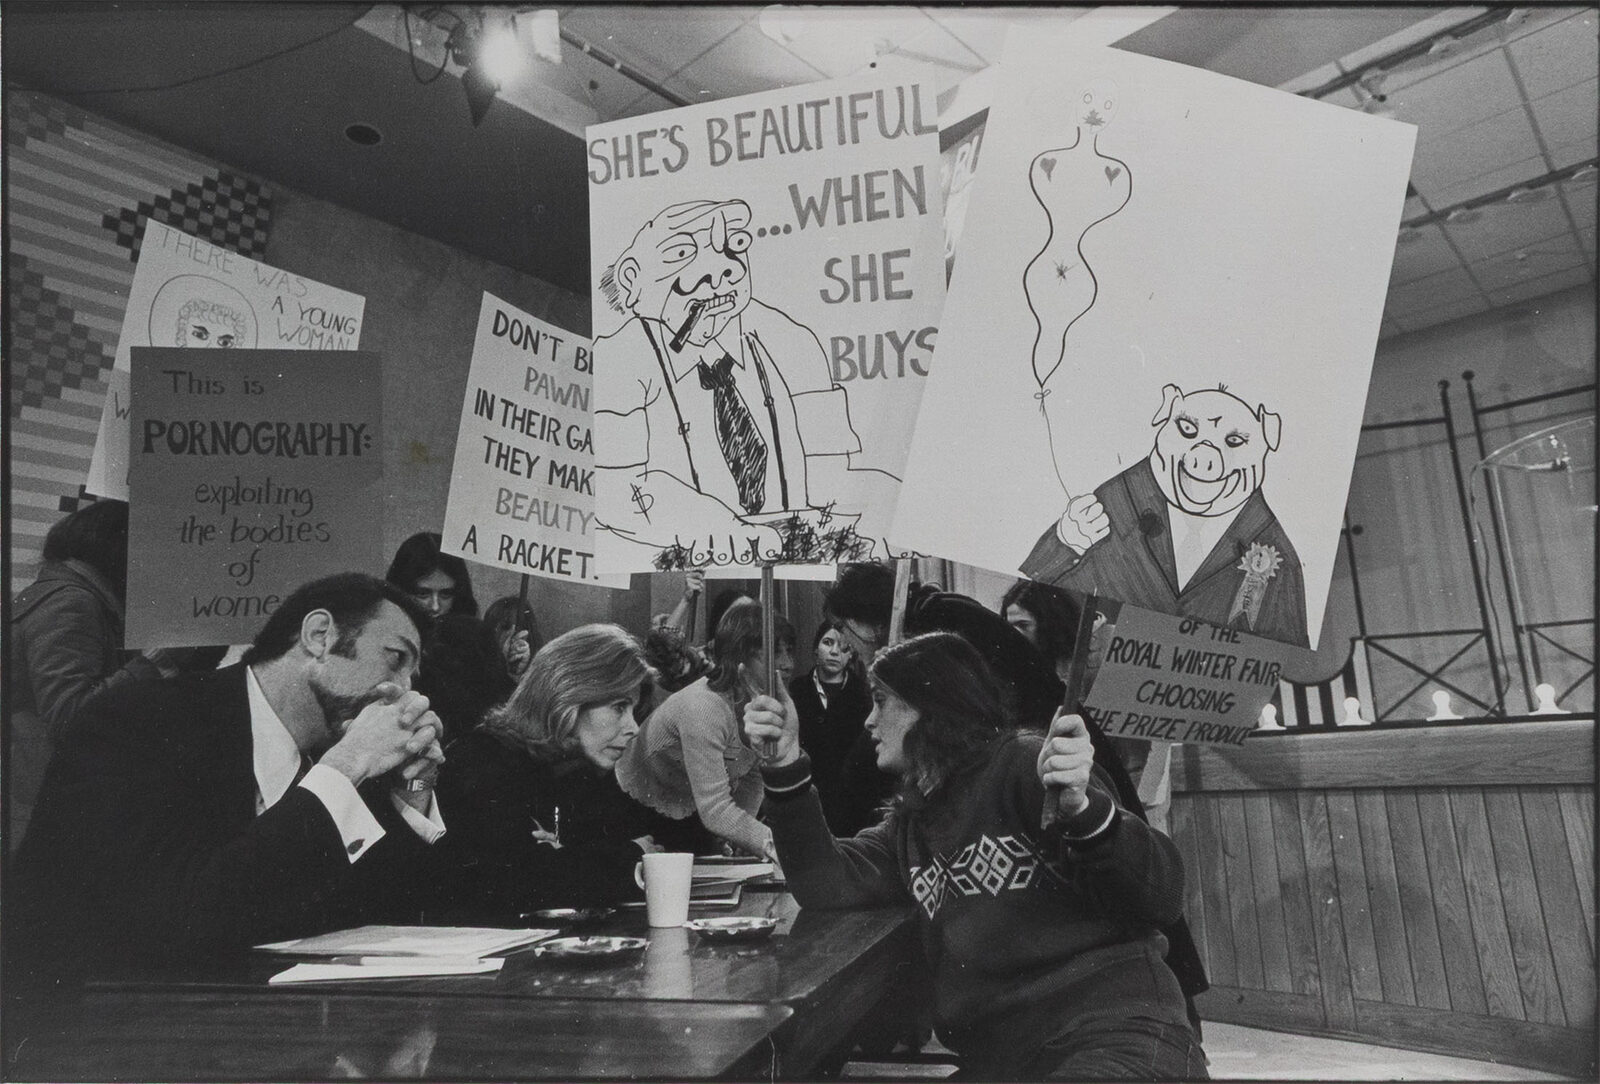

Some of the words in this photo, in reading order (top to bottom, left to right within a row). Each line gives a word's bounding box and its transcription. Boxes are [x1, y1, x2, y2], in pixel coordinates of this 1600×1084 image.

[588, 124, 689, 185] SHE'S
[706, 83, 939, 167] BEAUTIFUL
[161, 227, 233, 275] THERE
[253, 265, 308, 298] WAS
[819, 249, 914, 304] SHE
[272, 296, 284, 314] A
[298, 302, 356, 335] YOUNG
[277, 318, 350, 350] WOMAN
[492, 309, 563, 362] DON'T
[830, 327, 938, 383] BUYS
[163, 370, 225, 395] This
[243, 376, 265, 395] is
[523, 366, 590, 412] PAWN
[142, 419, 372, 458] PORNOGRAPHY:
[474, 388, 495, 421] IN
[500, 398, 561, 446] THEIR
[483, 435, 540, 479] THEY
[548, 460, 594, 496] MAK
[195, 476, 314, 516] exploiting
[495, 487, 594, 535] BEAUTY
[179, 515, 215, 545] the
[230, 515, 331, 543] bodies
[462, 525, 477, 554] A
[498, 534, 599, 580] RACKET.
[228, 548, 261, 586] of
[1179, 618, 1203, 636] OF
[1210, 622, 1241, 644] THE
[1105, 636, 1162, 669] ROYAL
[1171, 646, 1237, 680] WINTER
[1238, 658, 1281, 687] FAIR
[1136, 679, 1236, 714] CHOOSING
[1119, 712, 1187, 740] PRIZE
[1183, 720, 1251, 747] PRODUCE
